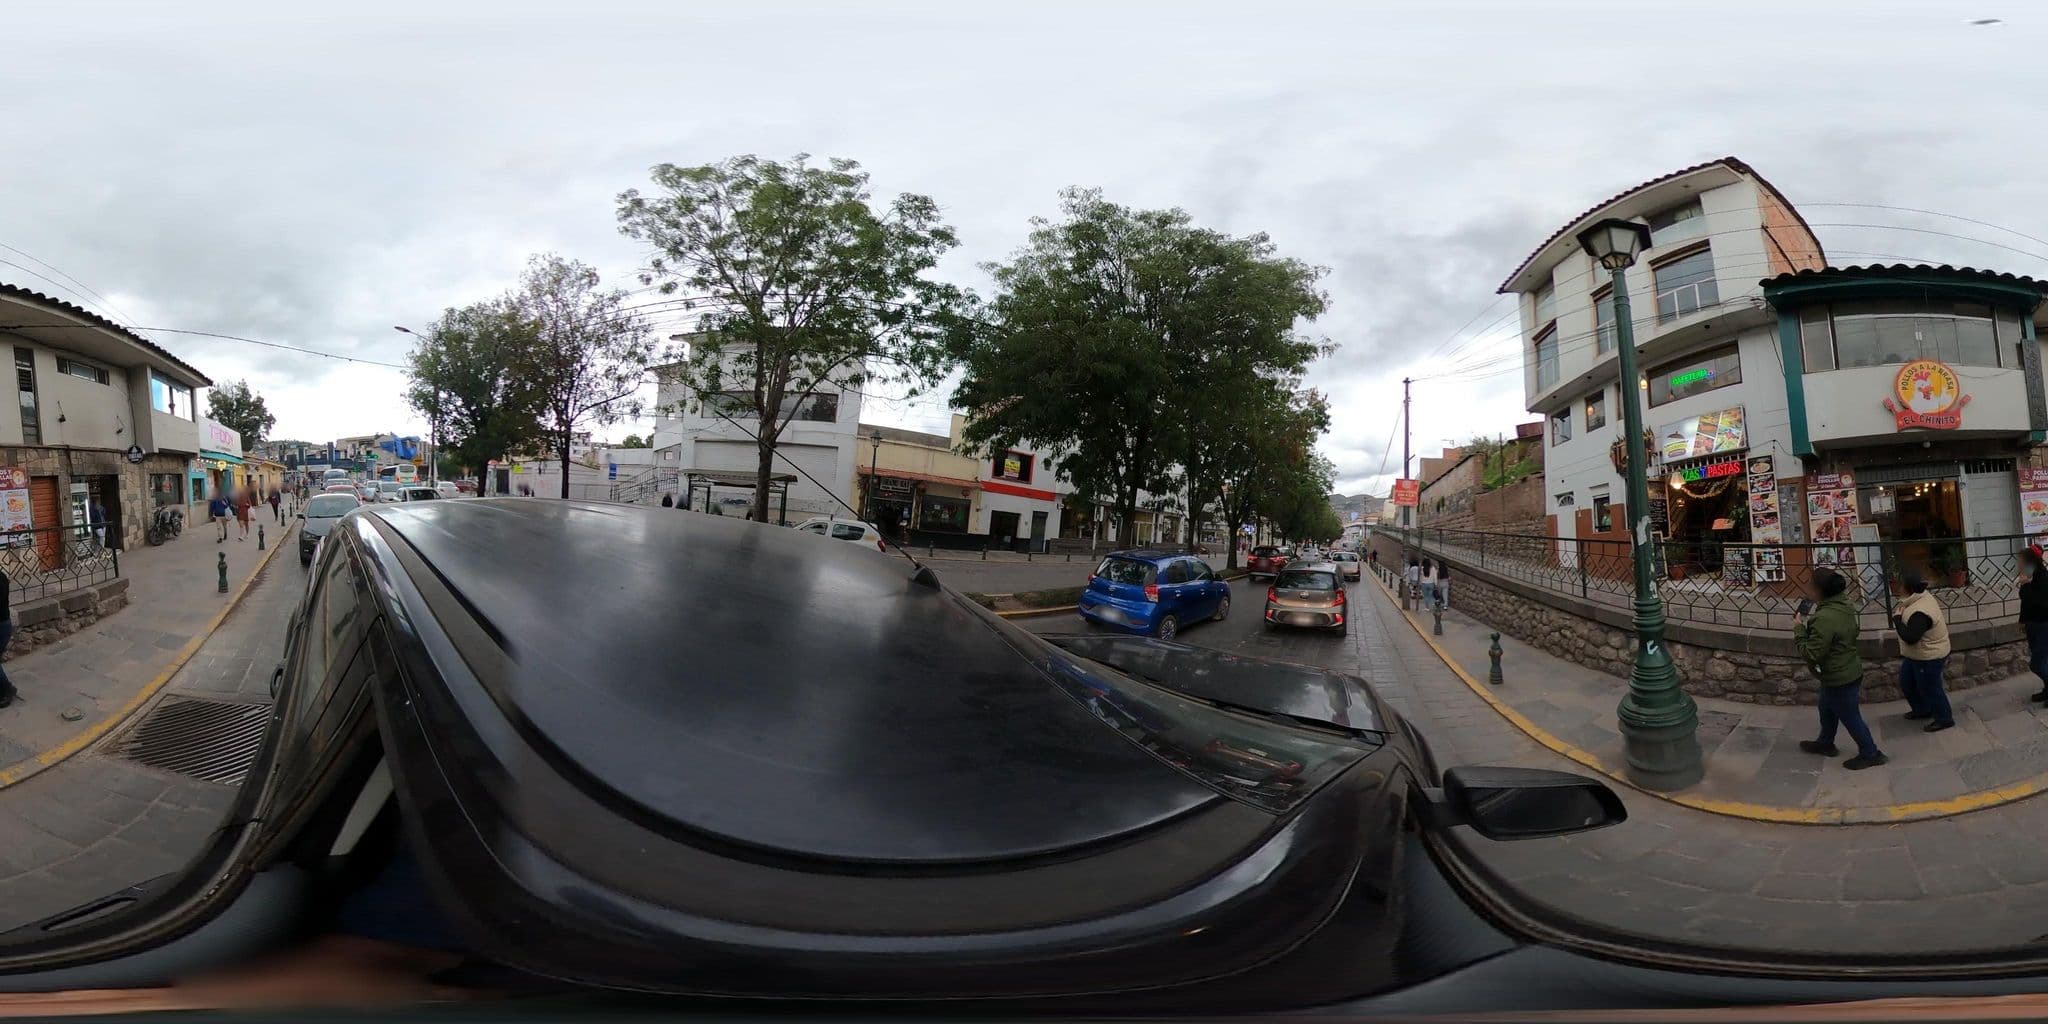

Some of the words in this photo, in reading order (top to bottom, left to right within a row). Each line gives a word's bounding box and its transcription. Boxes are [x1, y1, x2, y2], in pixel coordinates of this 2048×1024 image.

[1901, 367, 1918, 391] POLLOS
[1938, 368, 1954, 390] BRASA
[1904, 416, 1916, 424] EL
[1920, 415, 1955, 425] CHINITO
[1700, 466, 1706, 478] Y
[1707, 462, 1740, 477] PASTAS
